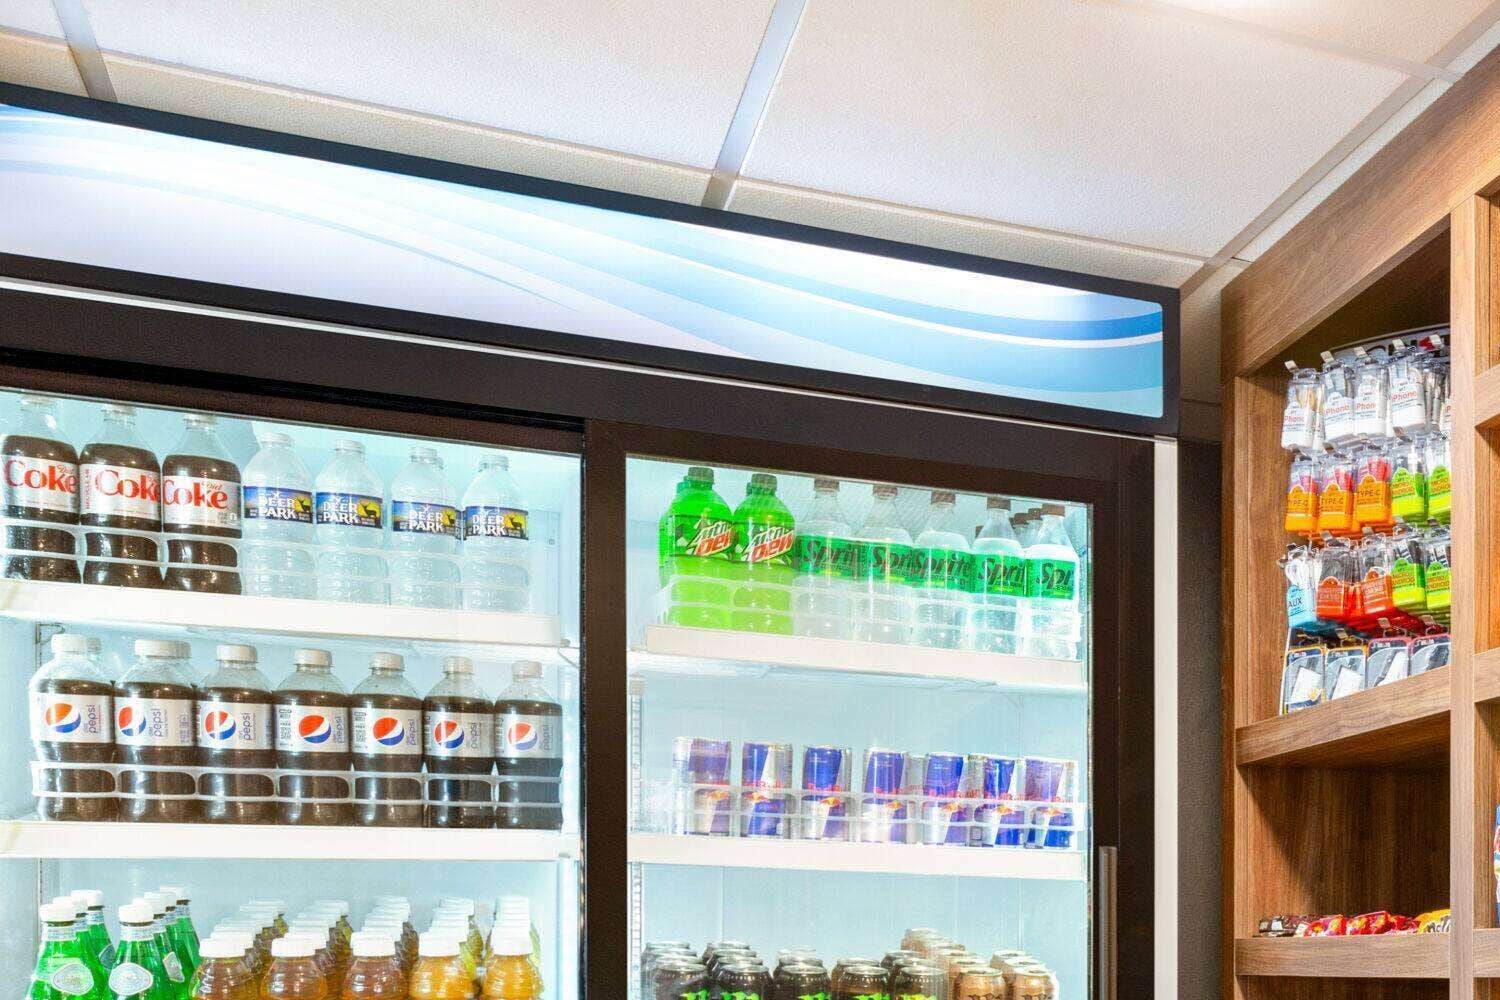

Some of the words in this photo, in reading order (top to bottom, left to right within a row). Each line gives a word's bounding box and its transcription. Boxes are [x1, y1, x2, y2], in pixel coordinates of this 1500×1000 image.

[4, 459, 78, 495] Coke
[163, 478, 229, 511] Coke
[259, 496, 295, 508] DEER
[323, 501, 358, 513] DEER
[259, 507, 297, 519] PARK
[323, 512, 359, 524] PARK
[409, 510, 443, 522] DEER
[409, 520, 444, 532] PARK
[472, 514, 505, 525] DEER
[472, 523, 506, 536] PARK
[806, 539, 858, 570] Sprit
[872, 545, 912, 575] Spri
[914, 549, 970, 576] Sprite
[979, 558, 1026, 586] Sprit
[89, 704, 98, 734] pepsi
[153, 708, 162, 737] pepsi
[243, 712, 252, 740] pepsi
[335, 716, 344, 743] pepsi
[408, 719, 416, 746] pepsi
[470, 722, 479, 749] pepsi
[541, 724, 550, 751] pepsi
